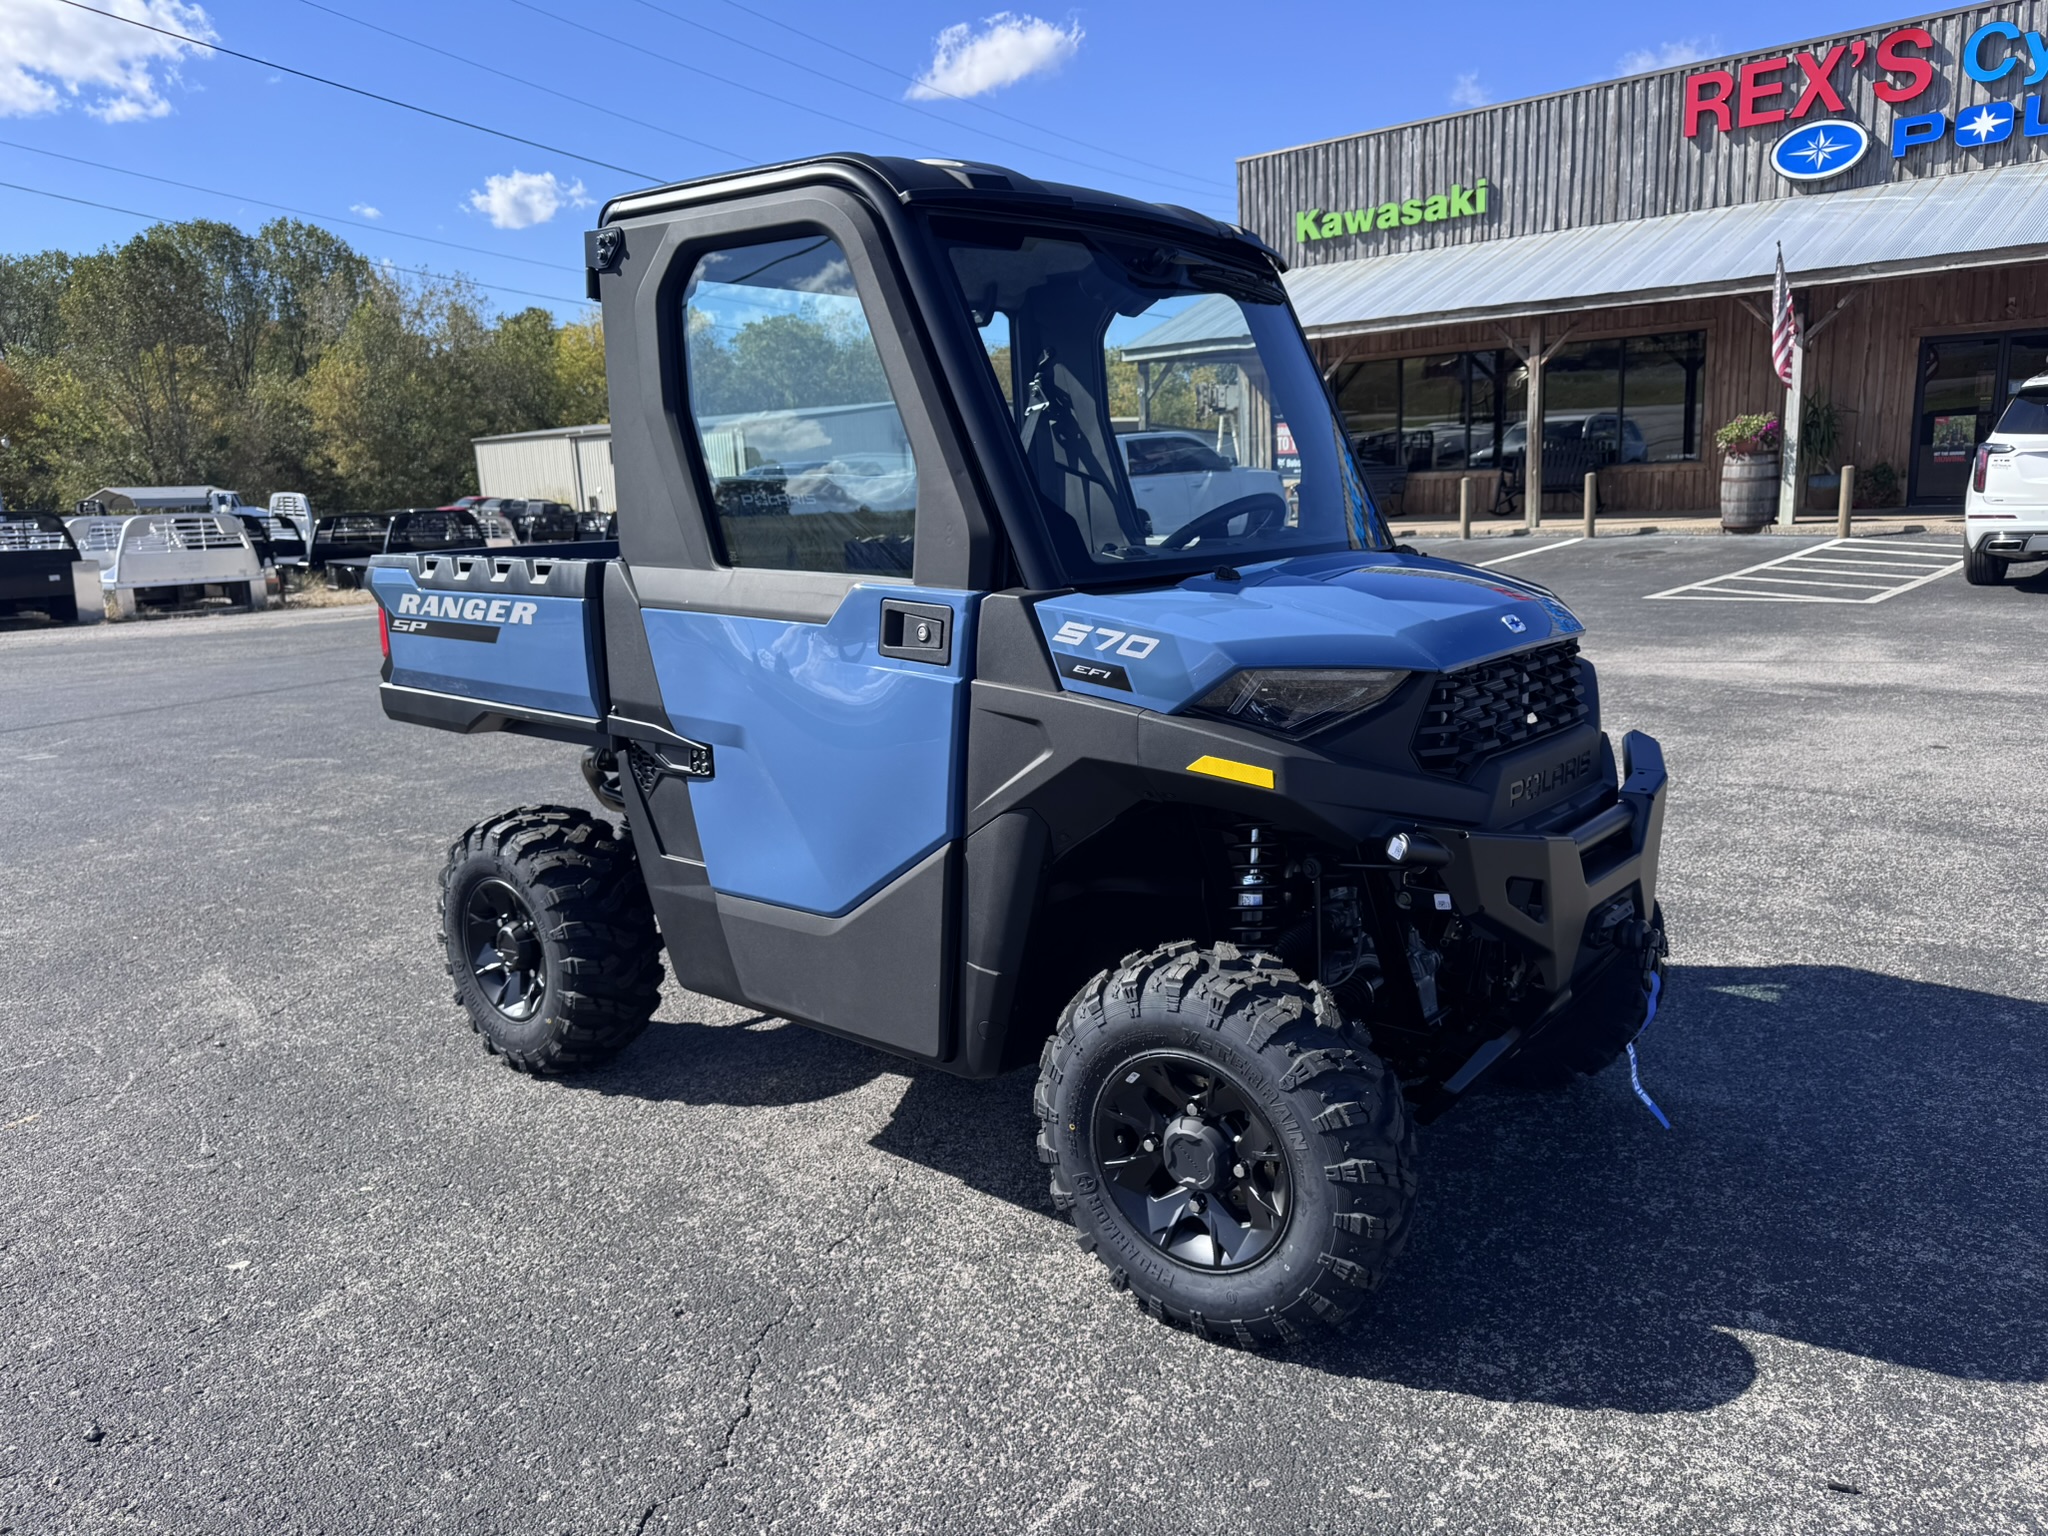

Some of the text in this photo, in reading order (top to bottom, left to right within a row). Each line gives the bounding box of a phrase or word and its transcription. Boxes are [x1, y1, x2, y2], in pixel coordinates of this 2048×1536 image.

[1683, 28, 1934, 138] REX'S
[1296, 178, 1488, 244] Kawasaki
[740, 493, 817, 507] POLARIS
[391, 619, 428, 633] SP
[398, 593, 538, 626] RANGER
[1052, 620, 1160, 660] 570
[1072, 664, 1112, 679] EFI
[1509, 749, 1591, 808] POLARIS
